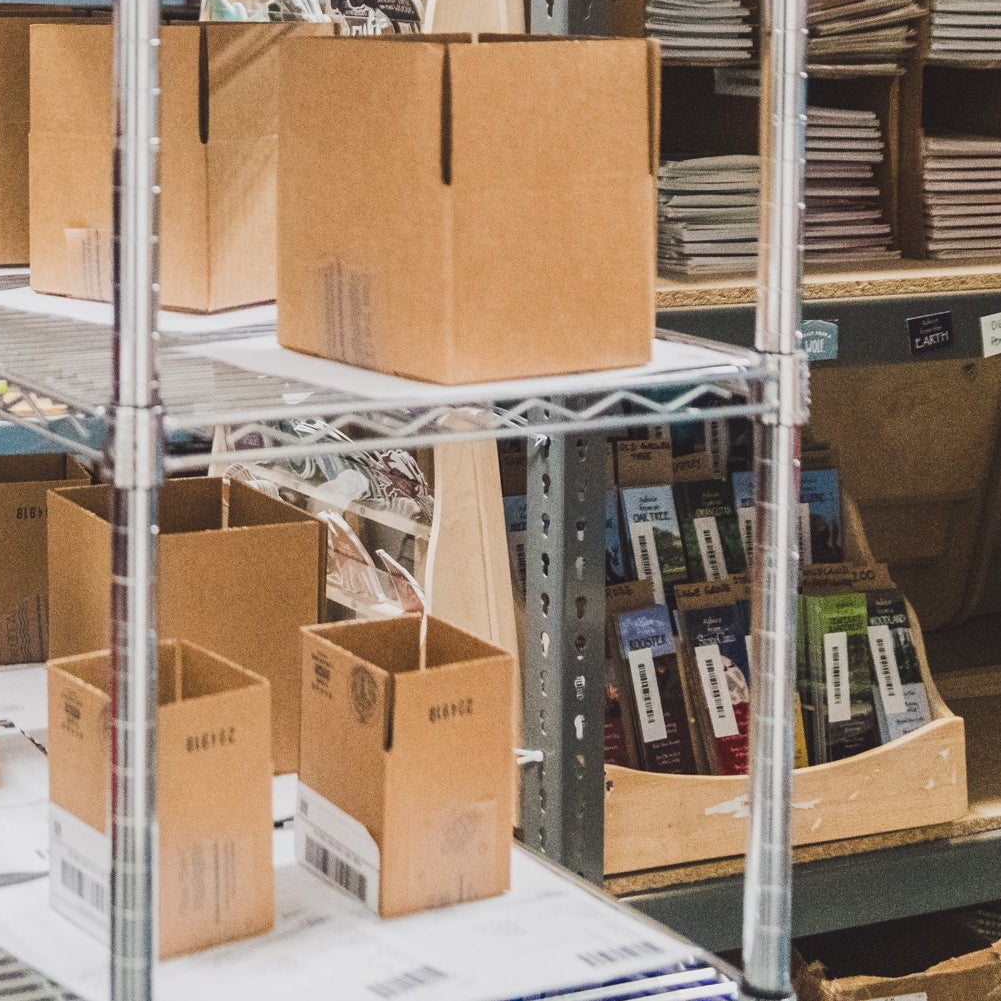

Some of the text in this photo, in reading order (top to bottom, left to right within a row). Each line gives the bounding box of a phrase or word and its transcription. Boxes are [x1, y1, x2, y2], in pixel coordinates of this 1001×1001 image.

[805, 338, 825, 353] WOLF
[914, 330, 950, 350] EARTH
[633, 510, 671, 523] OAK TREE
[869, 613, 906, 627] WOODLAND
[628, 634, 668, 650] ROOSTER
